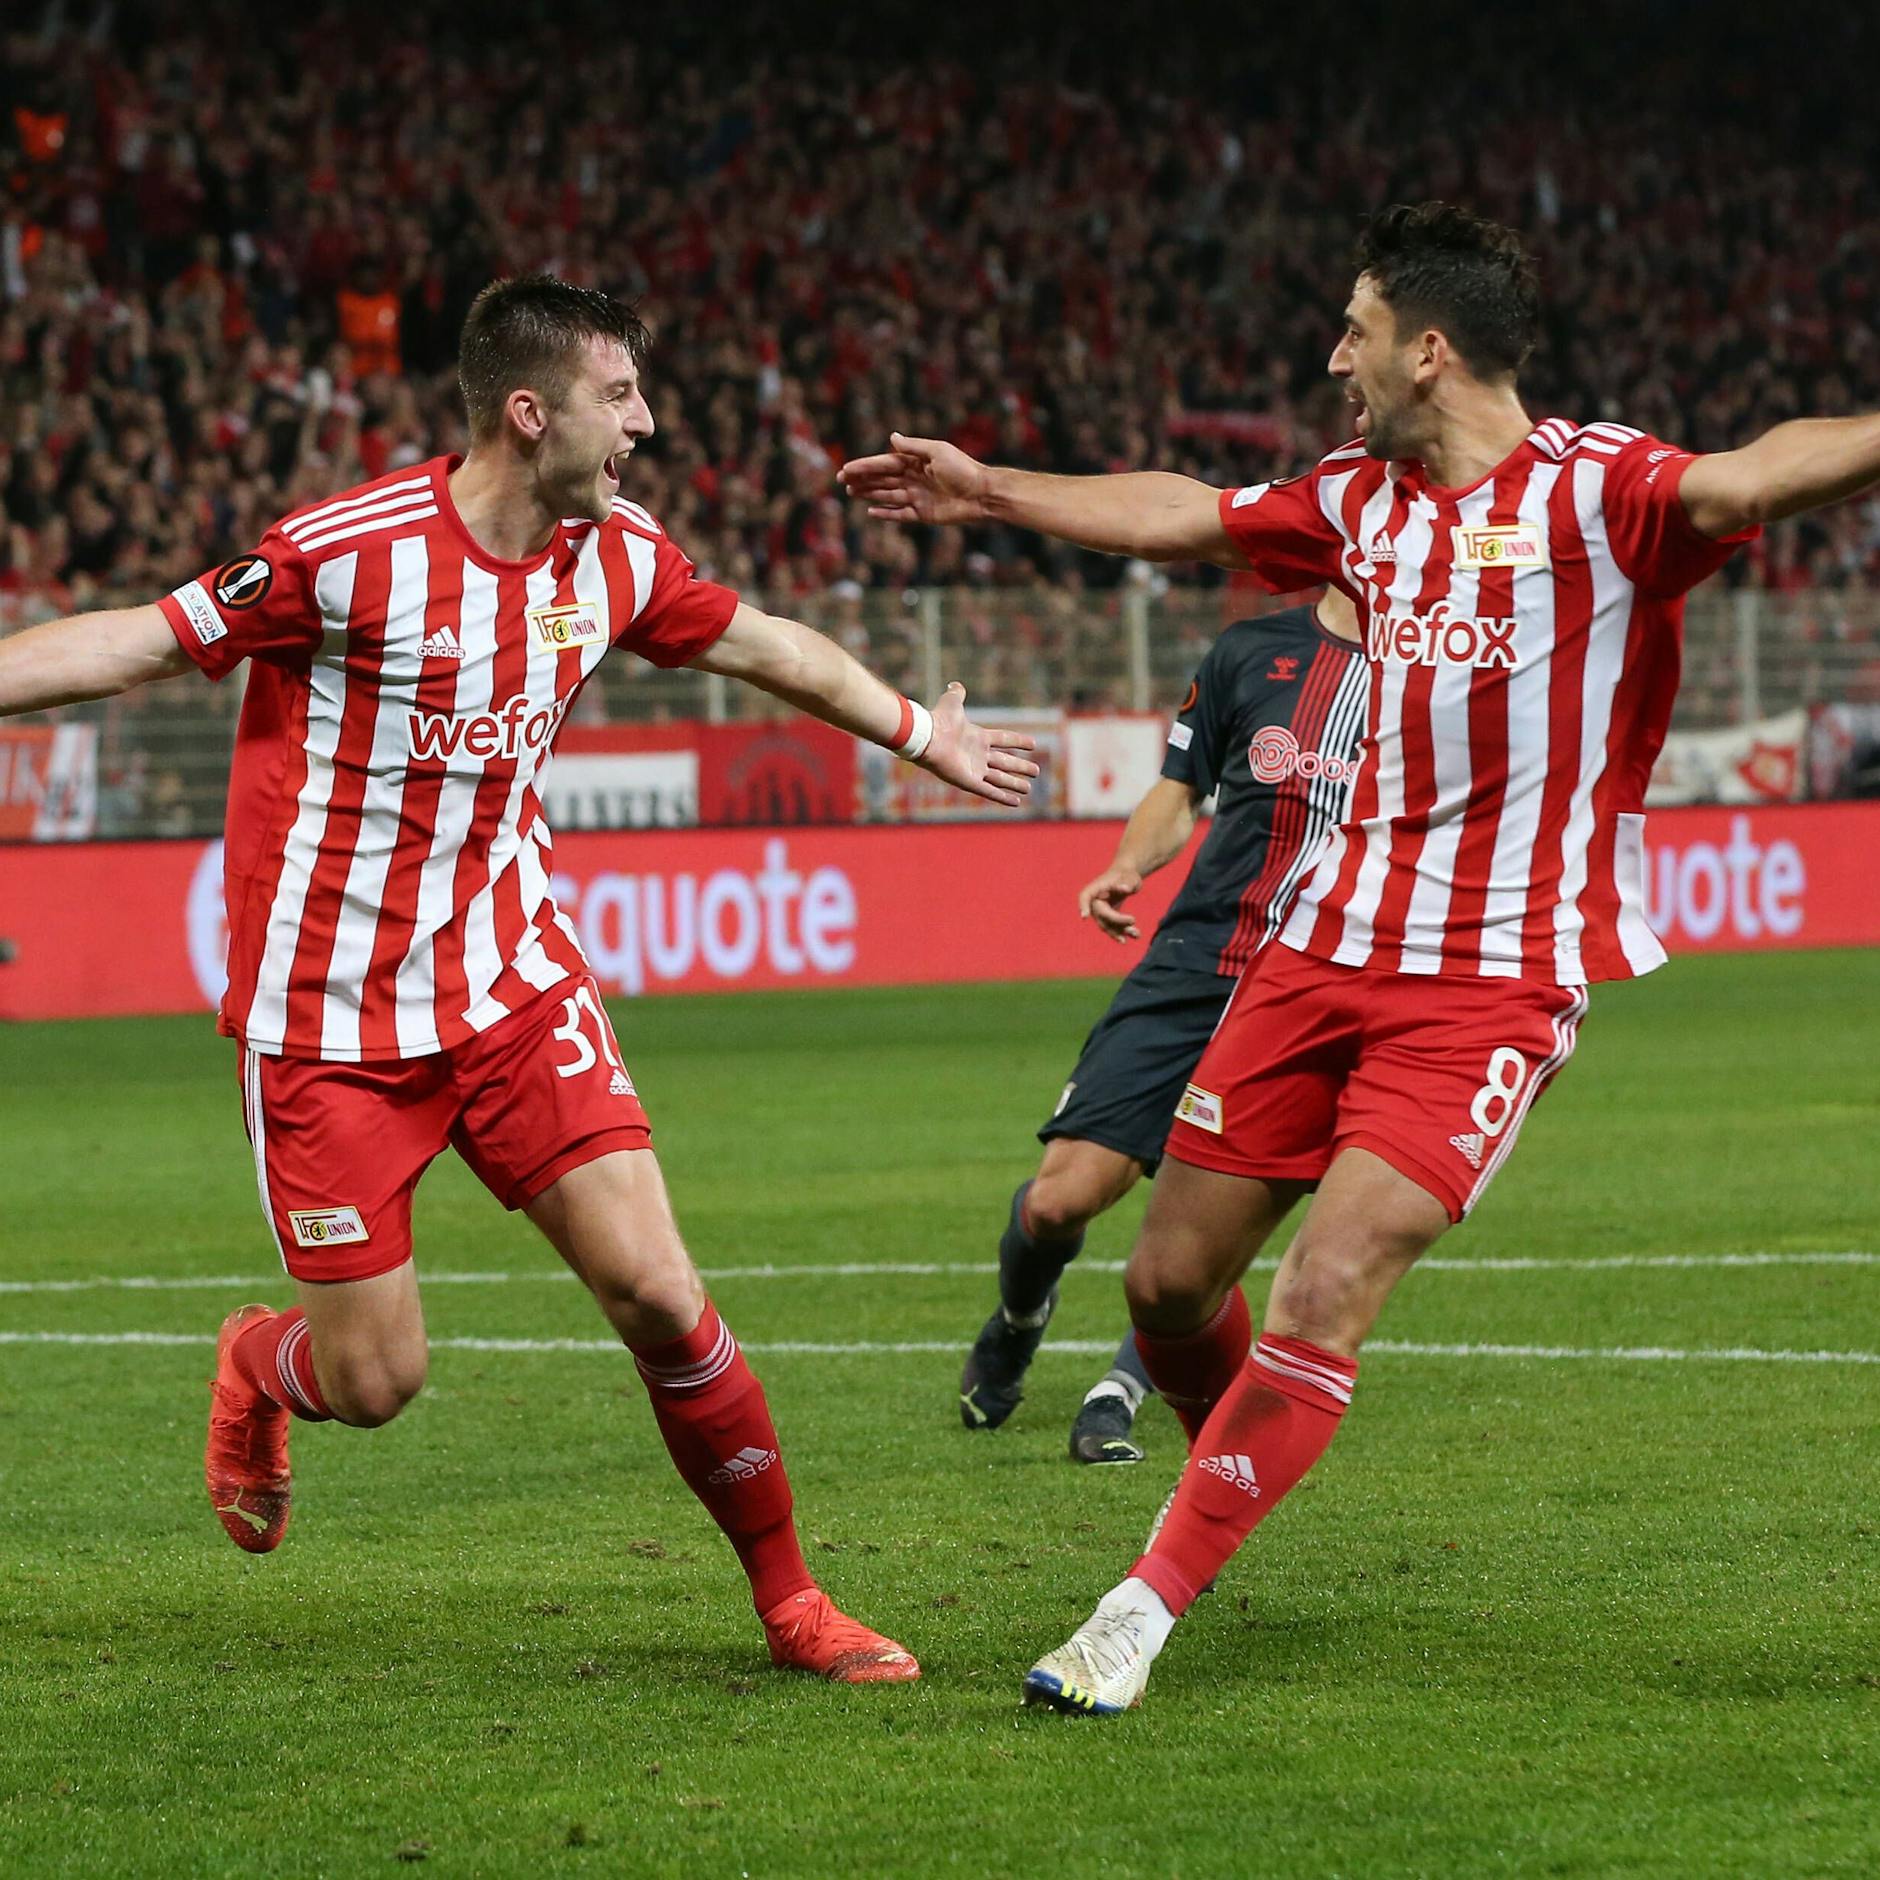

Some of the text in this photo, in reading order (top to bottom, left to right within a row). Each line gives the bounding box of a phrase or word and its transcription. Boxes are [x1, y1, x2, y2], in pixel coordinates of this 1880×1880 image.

[418, 645, 466, 659] adidas
[569, 619, 597, 636] UNION
[1370, 602, 1518, 666] wefox
[1644, 812, 1806, 940] uote
[552, 838, 857, 995] quote
[552, 986, 620, 1078] 31
[1470, 1046, 1527, 1138] 8
[327, 1221, 357, 1237] UNION
[1198, 1457, 1261, 1498] adidas
